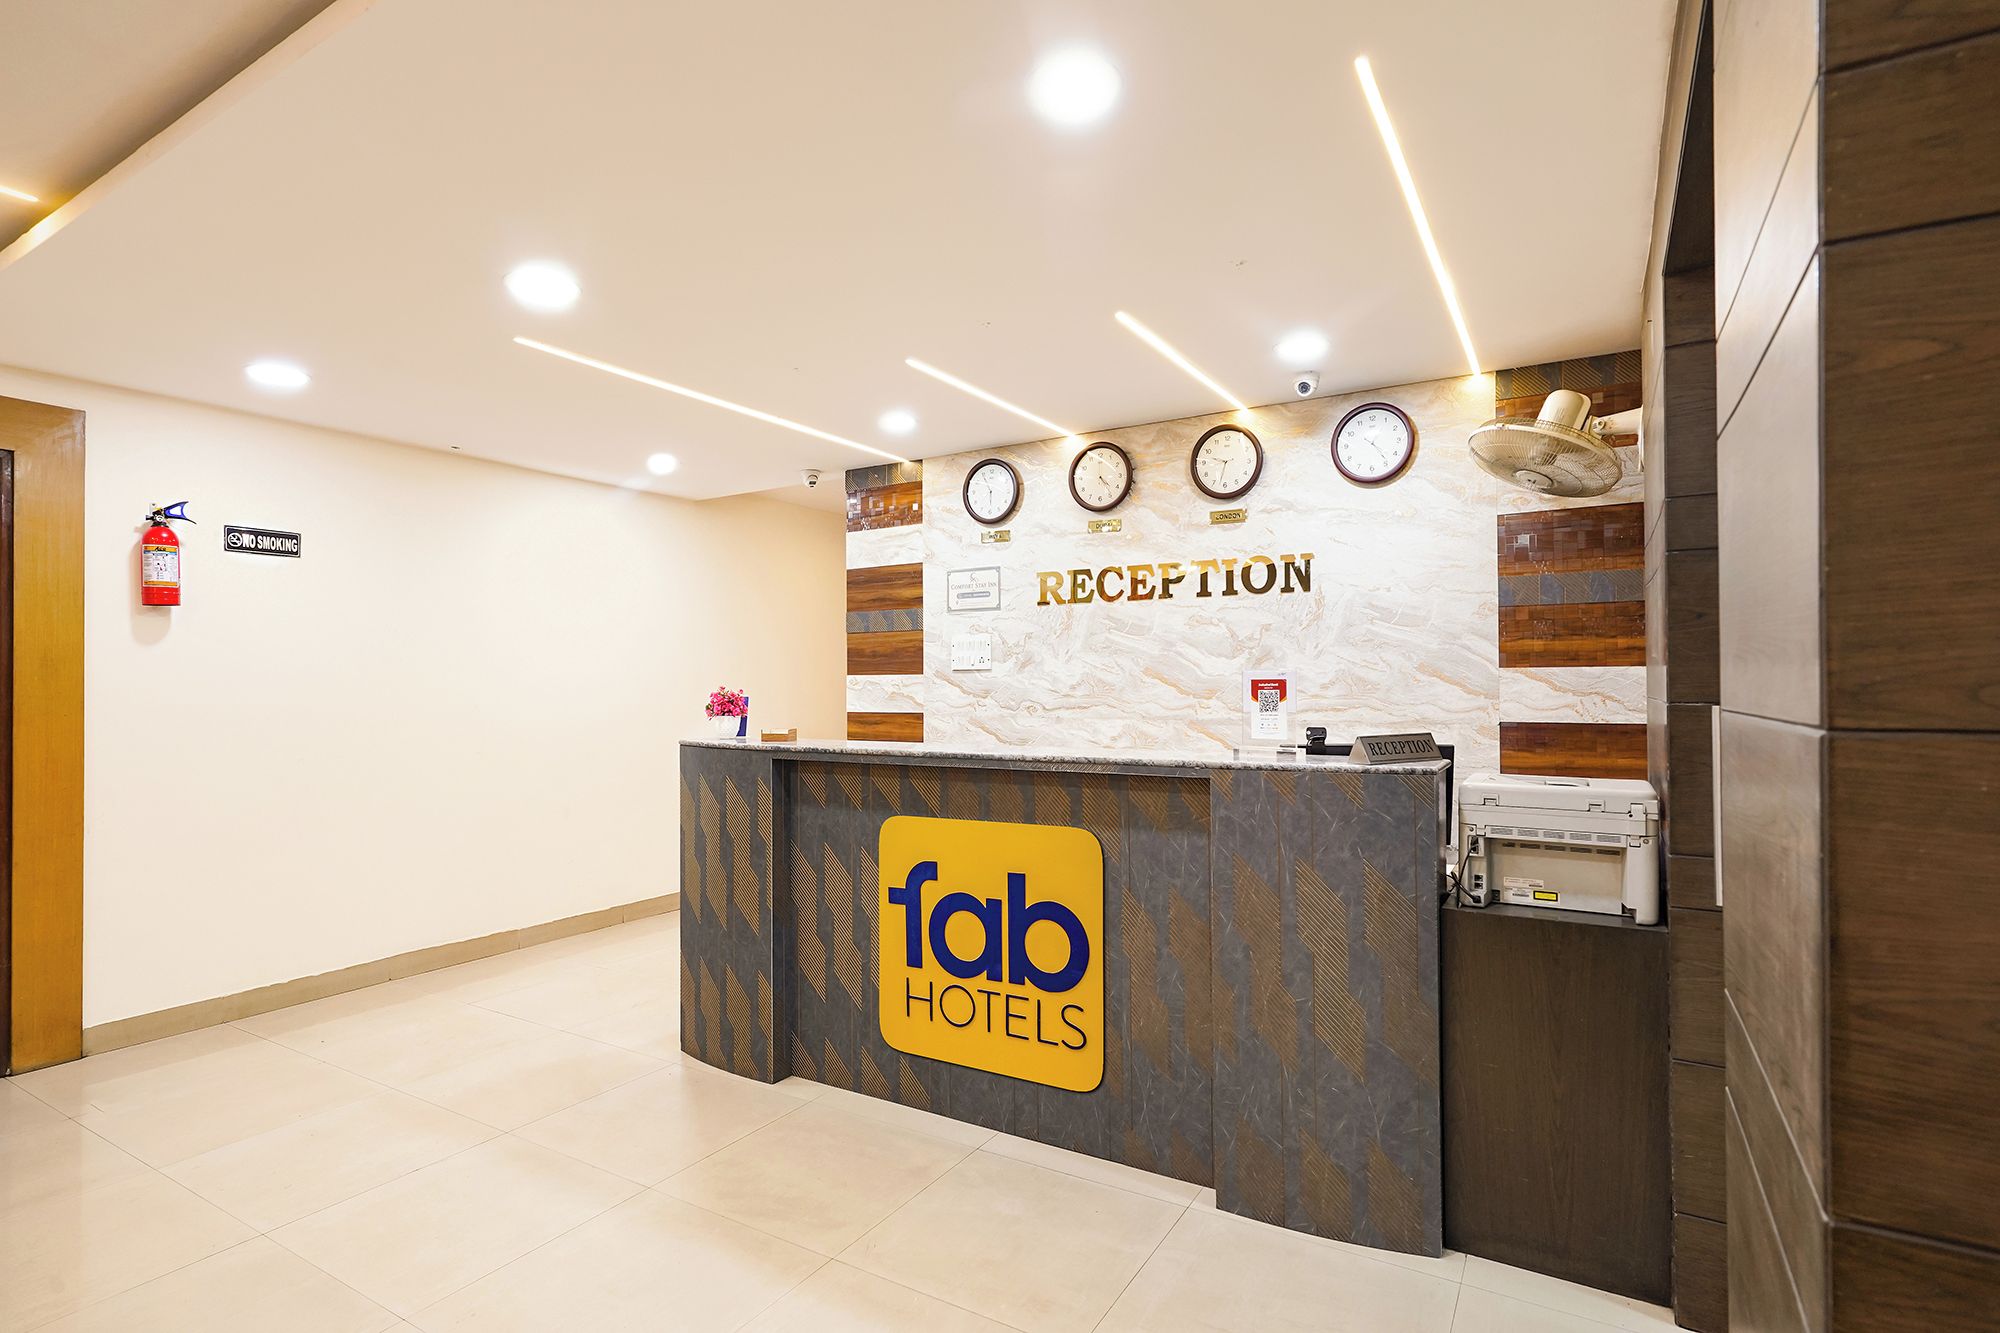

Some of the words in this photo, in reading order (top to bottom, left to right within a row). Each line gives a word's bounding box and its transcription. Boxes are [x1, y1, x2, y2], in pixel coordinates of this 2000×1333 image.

[241, 533, 256, 549] NO
[257, 535, 298, 552] SMOKING
[1036, 552, 1316, 606] RECEPTION
[1367, 739, 1434, 756] RECEPTION
[887, 861, 1090, 993] fab
[906, 977, 1088, 1050] HOTELS
